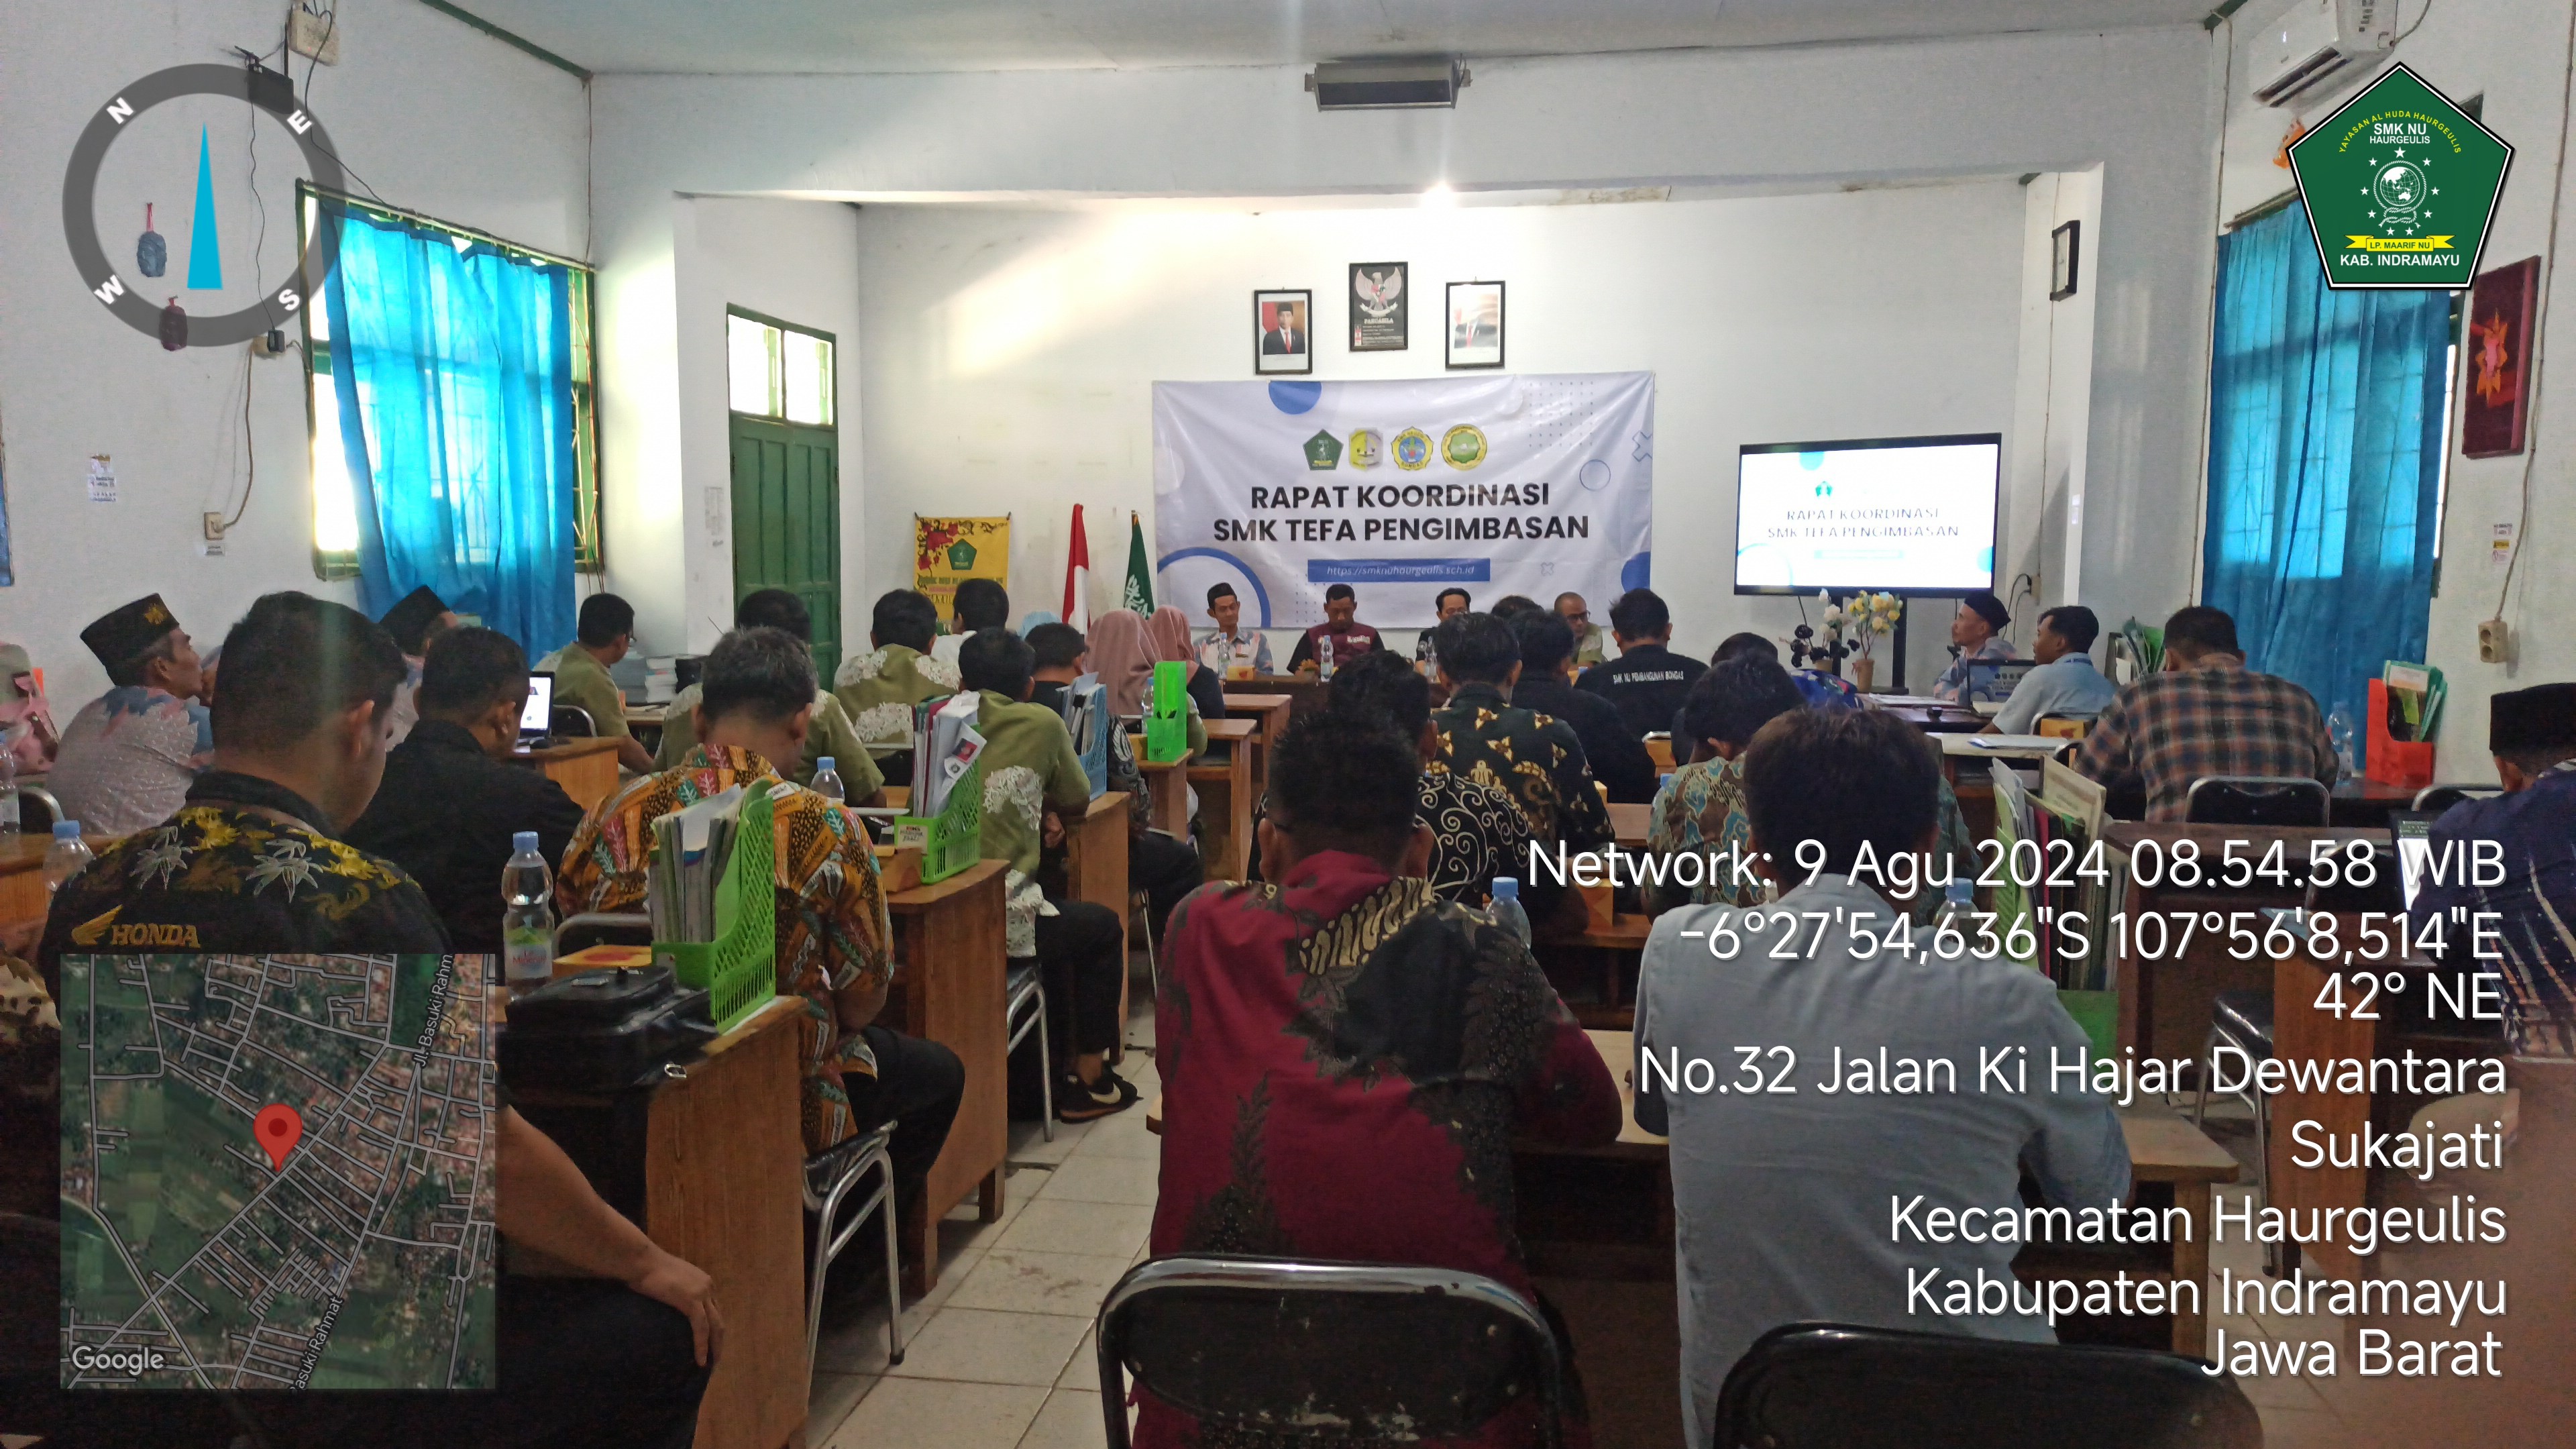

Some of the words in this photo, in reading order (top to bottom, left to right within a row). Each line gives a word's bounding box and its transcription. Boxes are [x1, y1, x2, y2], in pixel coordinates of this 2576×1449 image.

[1250, 486, 1349, 508] RAPAT
[1357, 483, 1550, 508] KOORDINASI
[1787, 509, 1835, 521] RAPAT
[1840, 507, 1939, 520] KOORDINASI
[1214, 519, 1277, 542] SMK
[1285, 519, 1356, 541] TEFA
[1364, 516, 1589, 541] PENGIMBASAN
[1768, 527, 1797, 537] SMK
[110, 923, 200, 949] HONDA
